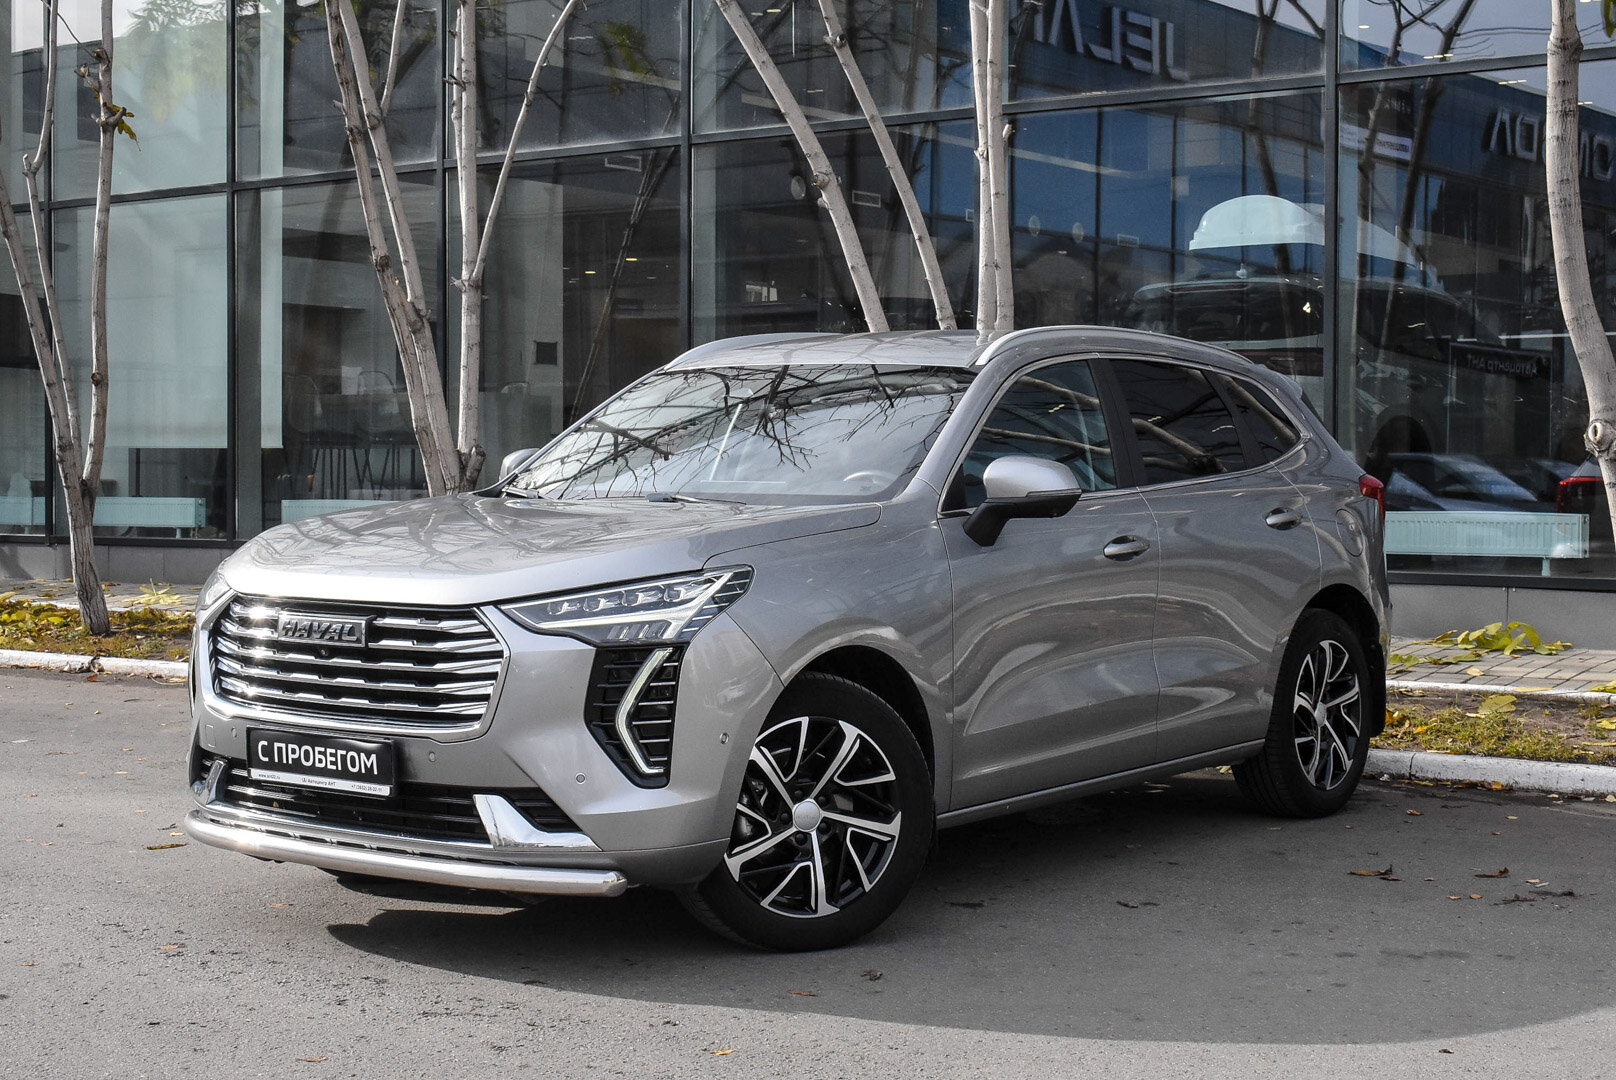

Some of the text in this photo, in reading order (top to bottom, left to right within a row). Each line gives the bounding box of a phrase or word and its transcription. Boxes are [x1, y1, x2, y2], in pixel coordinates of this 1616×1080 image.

[282, 620, 358, 641] HAVAL
[257, 740, 378, 775] С ПРОБЕГОМ
